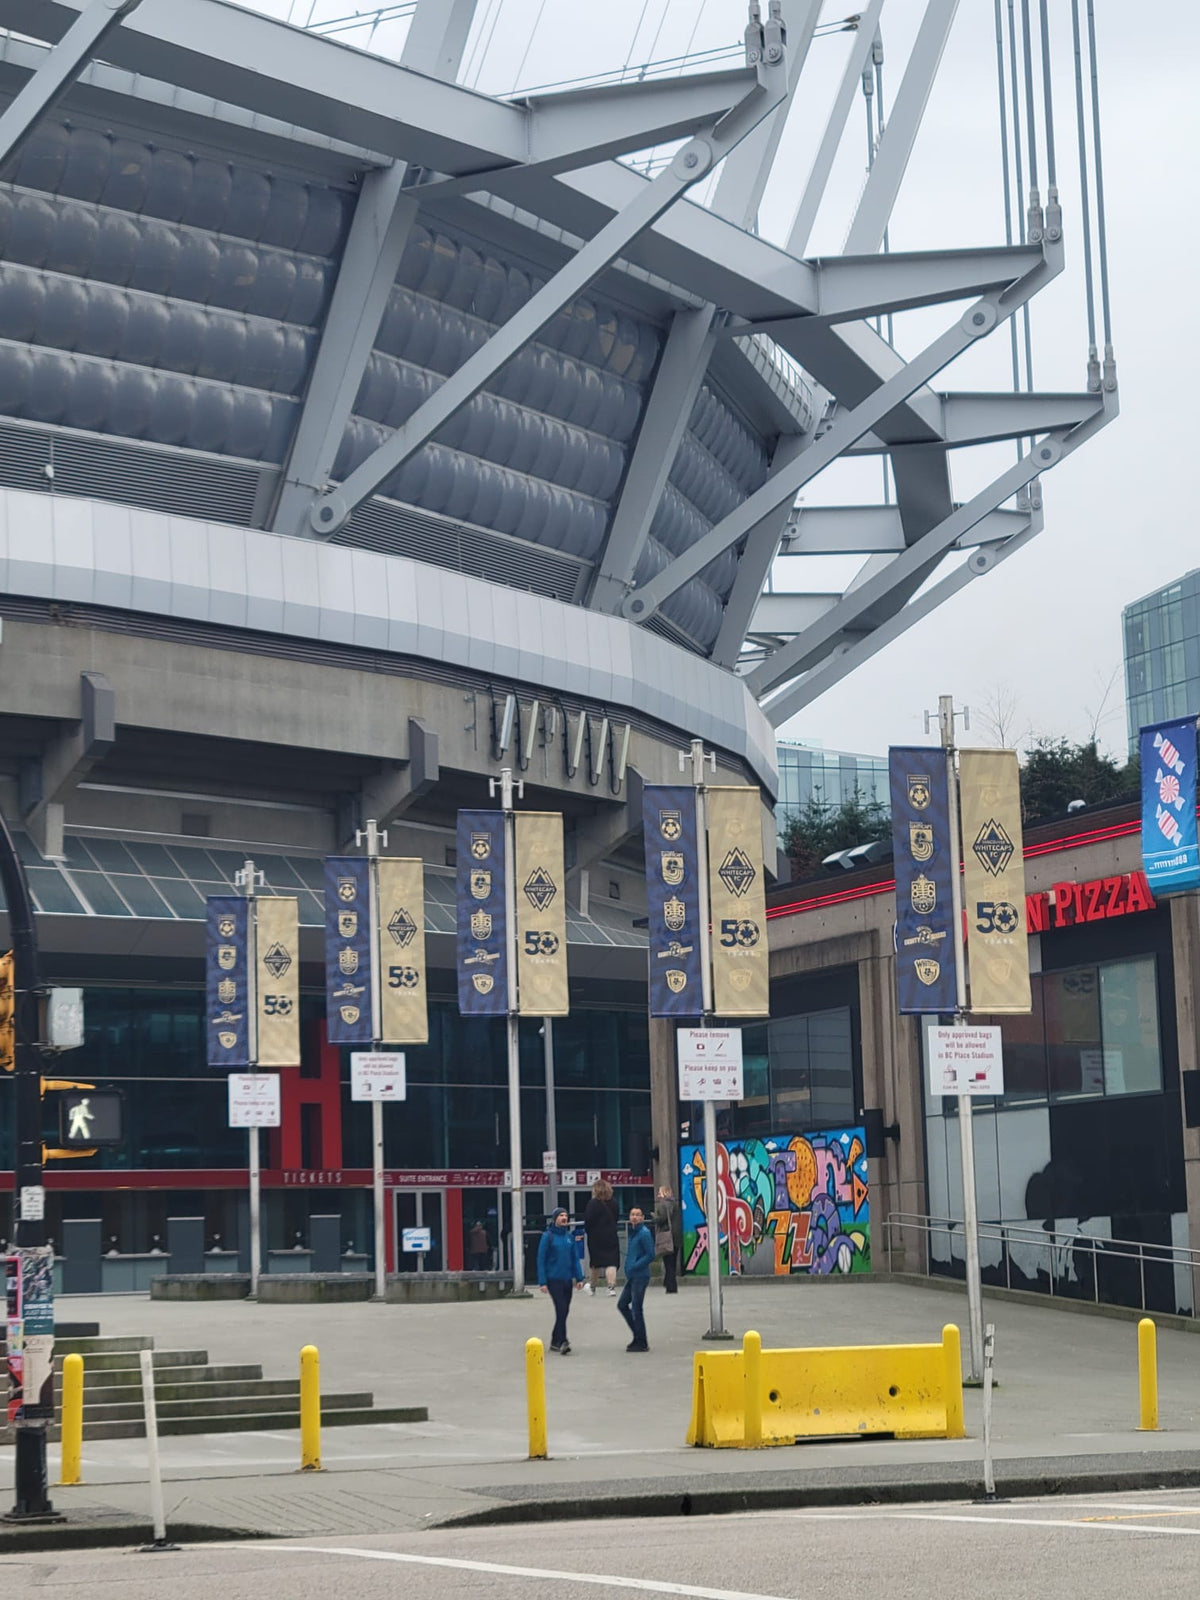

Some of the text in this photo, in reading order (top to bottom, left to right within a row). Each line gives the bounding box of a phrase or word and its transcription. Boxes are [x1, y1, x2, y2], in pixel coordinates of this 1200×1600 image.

[974, 843, 1013, 852] WHITECAPS
[989, 850, 999, 858] FC
[720, 868, 755, 876] WHITECAPS
[1052, 870, 1156, 928] PIZZA
[975, 901, 1019, 934] 50
[719, 919, 760, 948] 50
[938, 1031, 950, 1039] Only
[979, 1031, 992, 1039] bags
[283, 1172, 342, 1184] TICKETS
[399, 1175, 416, 1183] SUITE
[417, 1175, 448, 1183] ENTRANCE
